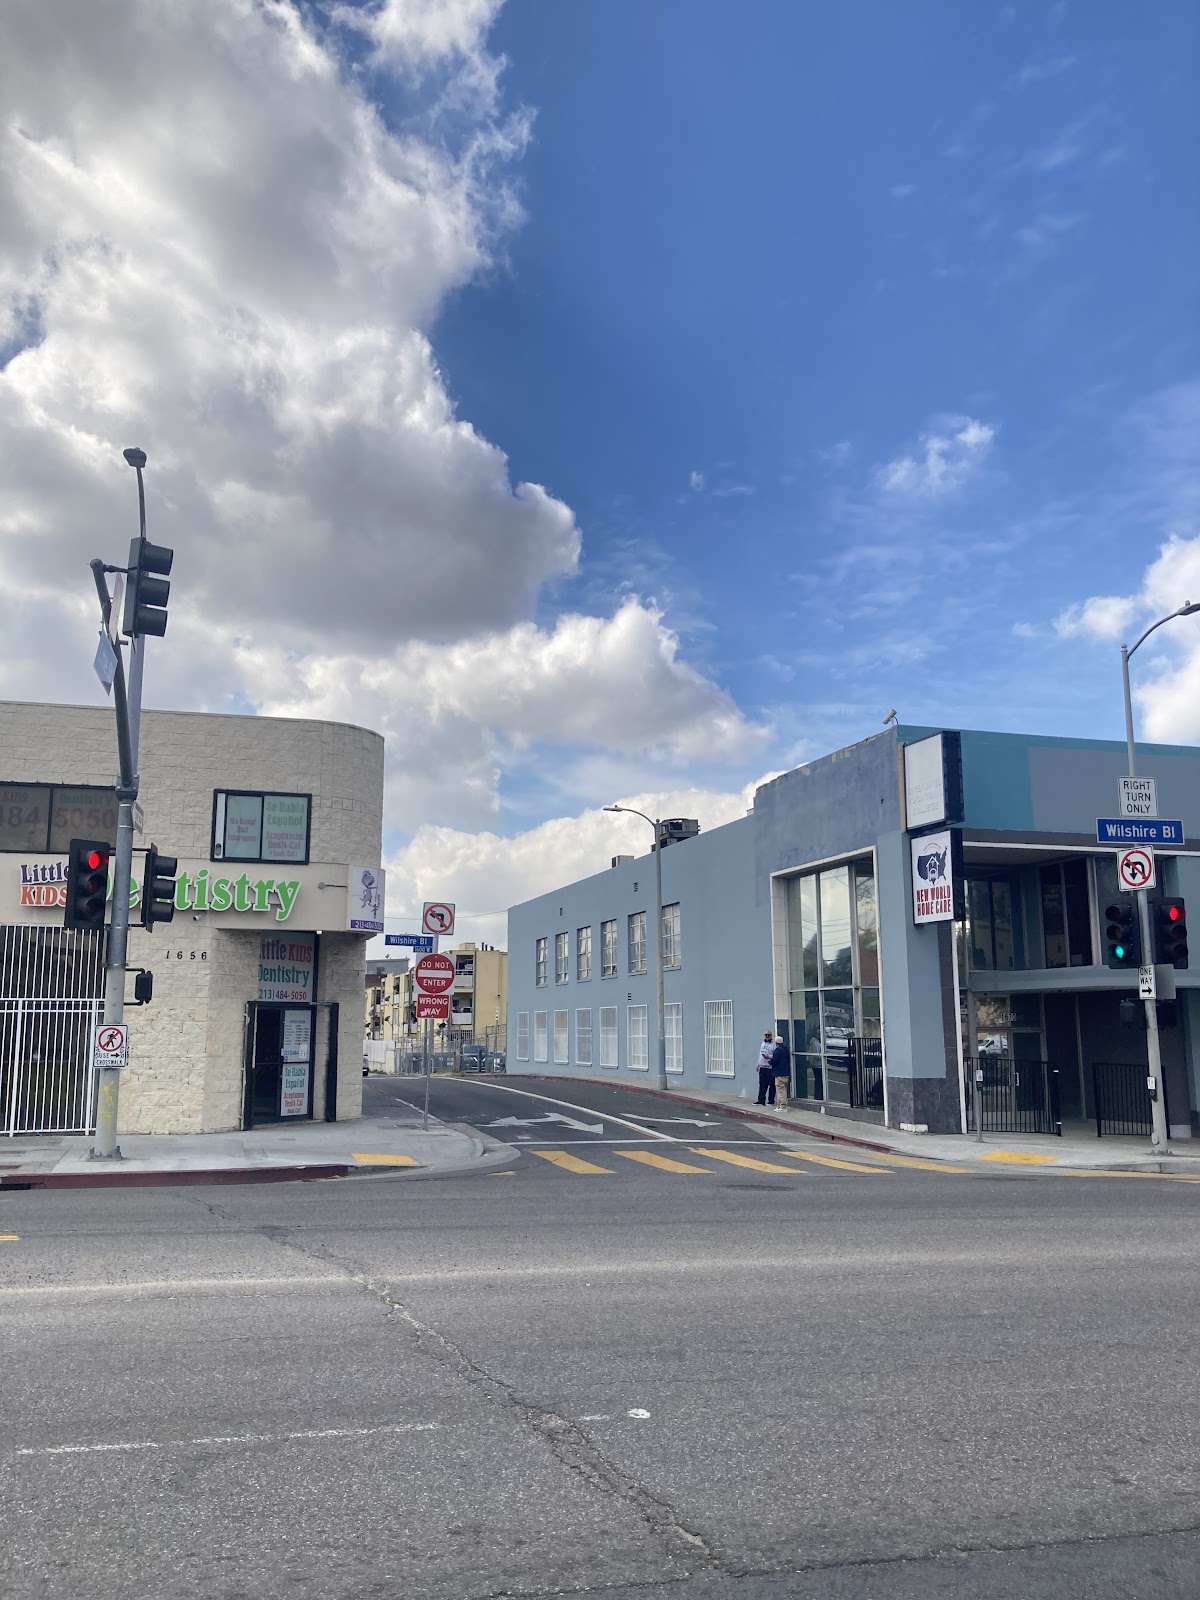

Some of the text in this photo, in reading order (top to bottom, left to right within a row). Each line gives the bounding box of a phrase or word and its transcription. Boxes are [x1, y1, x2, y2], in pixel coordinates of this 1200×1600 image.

[1123, 780, 1151, 790] RIGHT
[1125, 792, 1151, 802] TURN
[266, 801, 278, 812] Se
[1126, 803, 1151, 814] ONLY
[0, 805, 40, 828] 84
[54, 807, 116, 830] 5050
[1105, 823, 1175, 838] Wilshire Bl
[20, 885, 68, 906] KIDS
[916, 885, 951, 903] NEW WORLD
[917, 899, 951, 917] HOME CARE
[390, 935, 428, 945] Wilshire Bl
[165, 950, 208, 961] 1656
[259, 939, 313, 963] ittle KIDS
[421, 960, 450, 969] DO NOT
[1139, 966, 1153, 976] ONE
[423, 979, 446, 987] ENTER
[1140, 976, 1153, 985] WAY
[275, 990, 307, 1000] 484-5050
[419, 997, 448, 1006] WRONG
[424, 1007, 441, 1016] WAY
